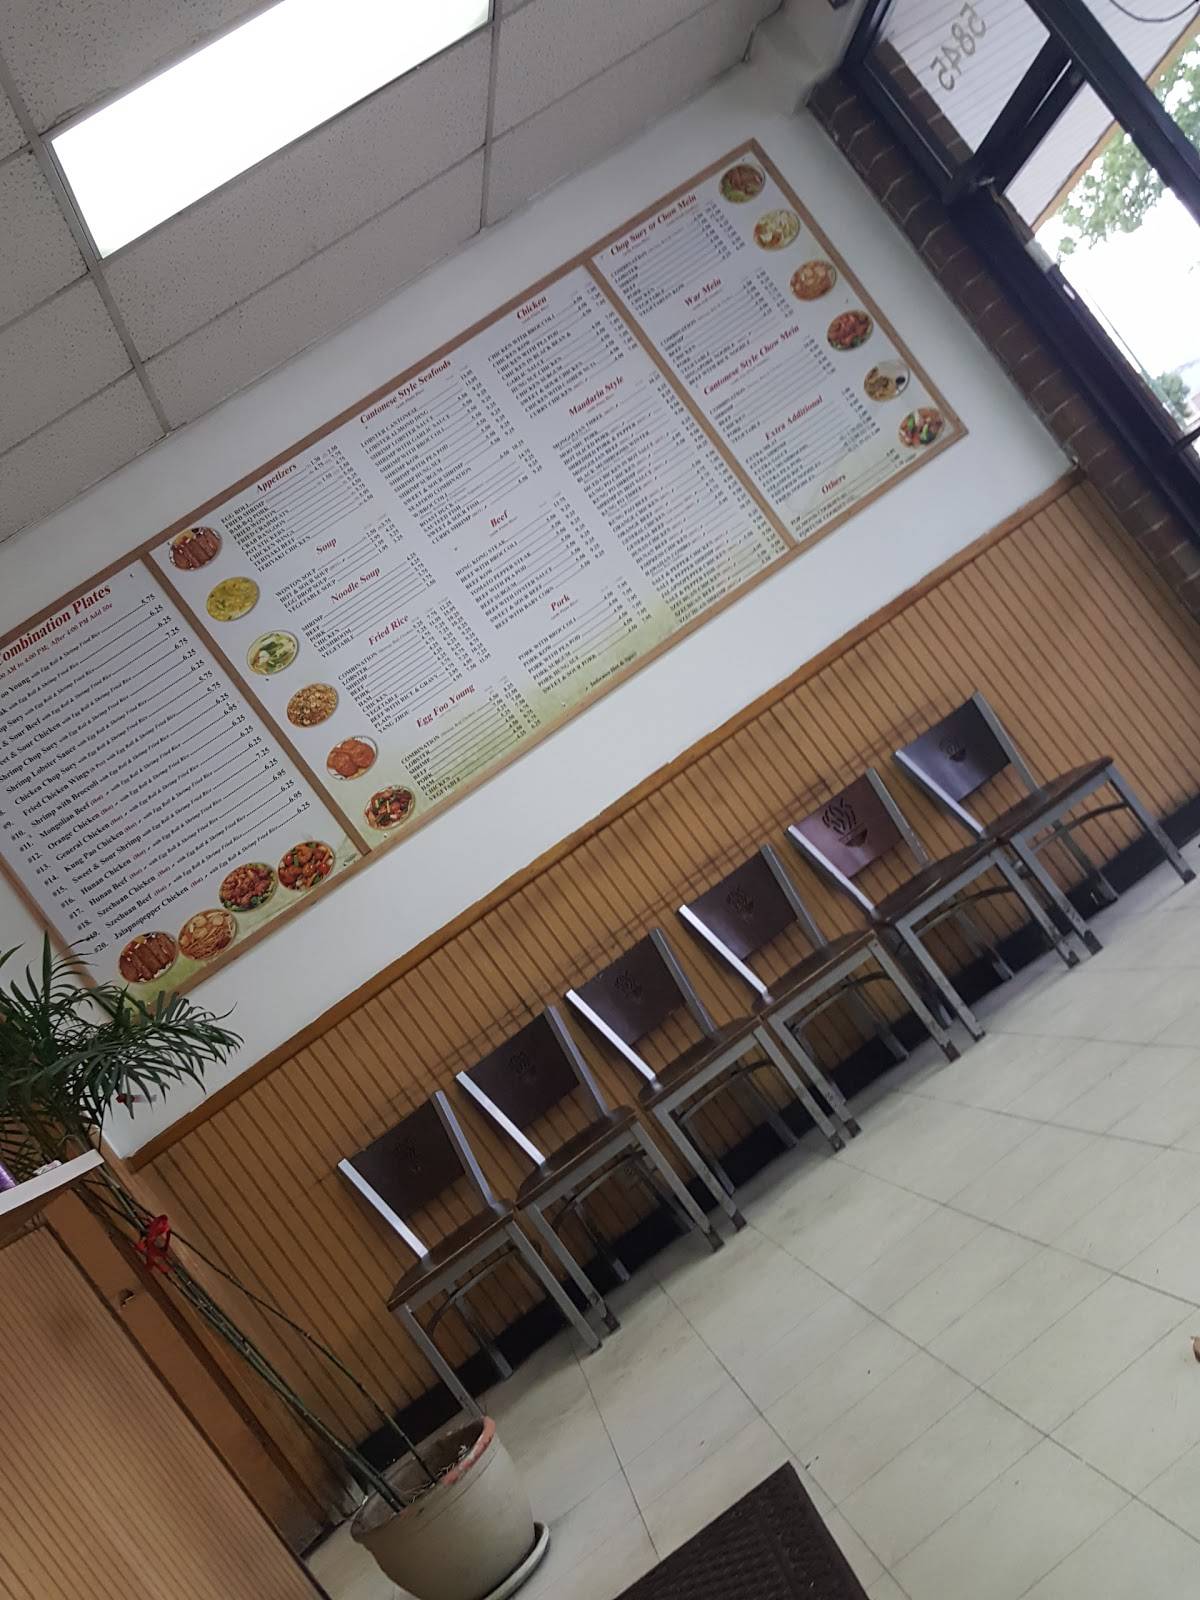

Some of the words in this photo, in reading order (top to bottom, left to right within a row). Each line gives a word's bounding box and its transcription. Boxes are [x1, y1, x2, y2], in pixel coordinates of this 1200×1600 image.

[515, 295, 547, 320] Chicken
[359, 395, 397, 424] Cantonese
[396, 381, 418, 399] Style
[417, 359, 451, 384] Seafoods
[568, 388, 605, 416] Mandarin
[603, 375, 624, 392] Style
[256, 462, 297, 493] Appetizers
[489, 509, 509, 527] Beef
[315, 536, 338, 555] Soup
[330, 580, 359, 603] Noodle
[359, 566, 381, 584] Soup
[550, 593, 570, 611] Pork
[0, 610, 71, 665] ombination
[70, 585, 111, 615] Plates
[367, 625, 390, 645] Fried
[389, 614, 409, 631] Rice
[8, 676, 31, 692] Young
[415, 712, 434, 728] Egg
[432, 701, 449, 716] Foo
[448, 683, 476, 705] Young
[8, 728, 25, 741] Sour
[24, 717, 41, 731] Beef
[16, 740, 34, 753] Sour
[32, 721, 61, 742] Chicken
[0, 763, 24, 783] Shrimp
[22, 751, 42, 766] Chop
[40, 741, 58, 754] Suey
[5, 774, 32, 794] Shrimp
[30, 757, 57, 777] Lobster
[55, 744, 76, 760] Sauce
[14, 784, 42, 805] Chicken
[41, 772, 61, 787] Chop
[59, 761, 77, 775] Suey
[22, 800, 42, 816] Fried
[40, 783, 69, 804] Chicken
[67, 769, 90, 786] Wings
[30, 808, 57, 827] Shrimp
[55, 798, 72, 810] with
[70, 779, 99, 801] Broccoli
[38, 813, 75, 838] Mongolian
[73, 801, 90, 815] Beef
[47, 830, 73, 850] Orange
[72, 812, 100, 833] Chicken
[55, 840, 83, 861] General
[81, 822, 110, 843] Chicken
[63, 856, 84, 873] Kung
[82, 848, 97, 859] Pao
[95, 829, 124, 850] Chicken
[71, 867, 92, 883] Sweet
[99, 851, 116, 865] Sour
[115, 834, 142, 854] Shrimp
[80, 876, 104, 895] Hunan
[103, 858, 131, 879] Chicken
[88, 887, 112, 906] Hunan
[111, 876, 128, 890] Beef
[96, 893, 129, 918] Szechuan
[127, 874, 156, 896] Chicken
[104, 904, 137, 928] Szechuan
[135, 892, 152, 907] Beef
[160, 885, 189, 907] Chicken
